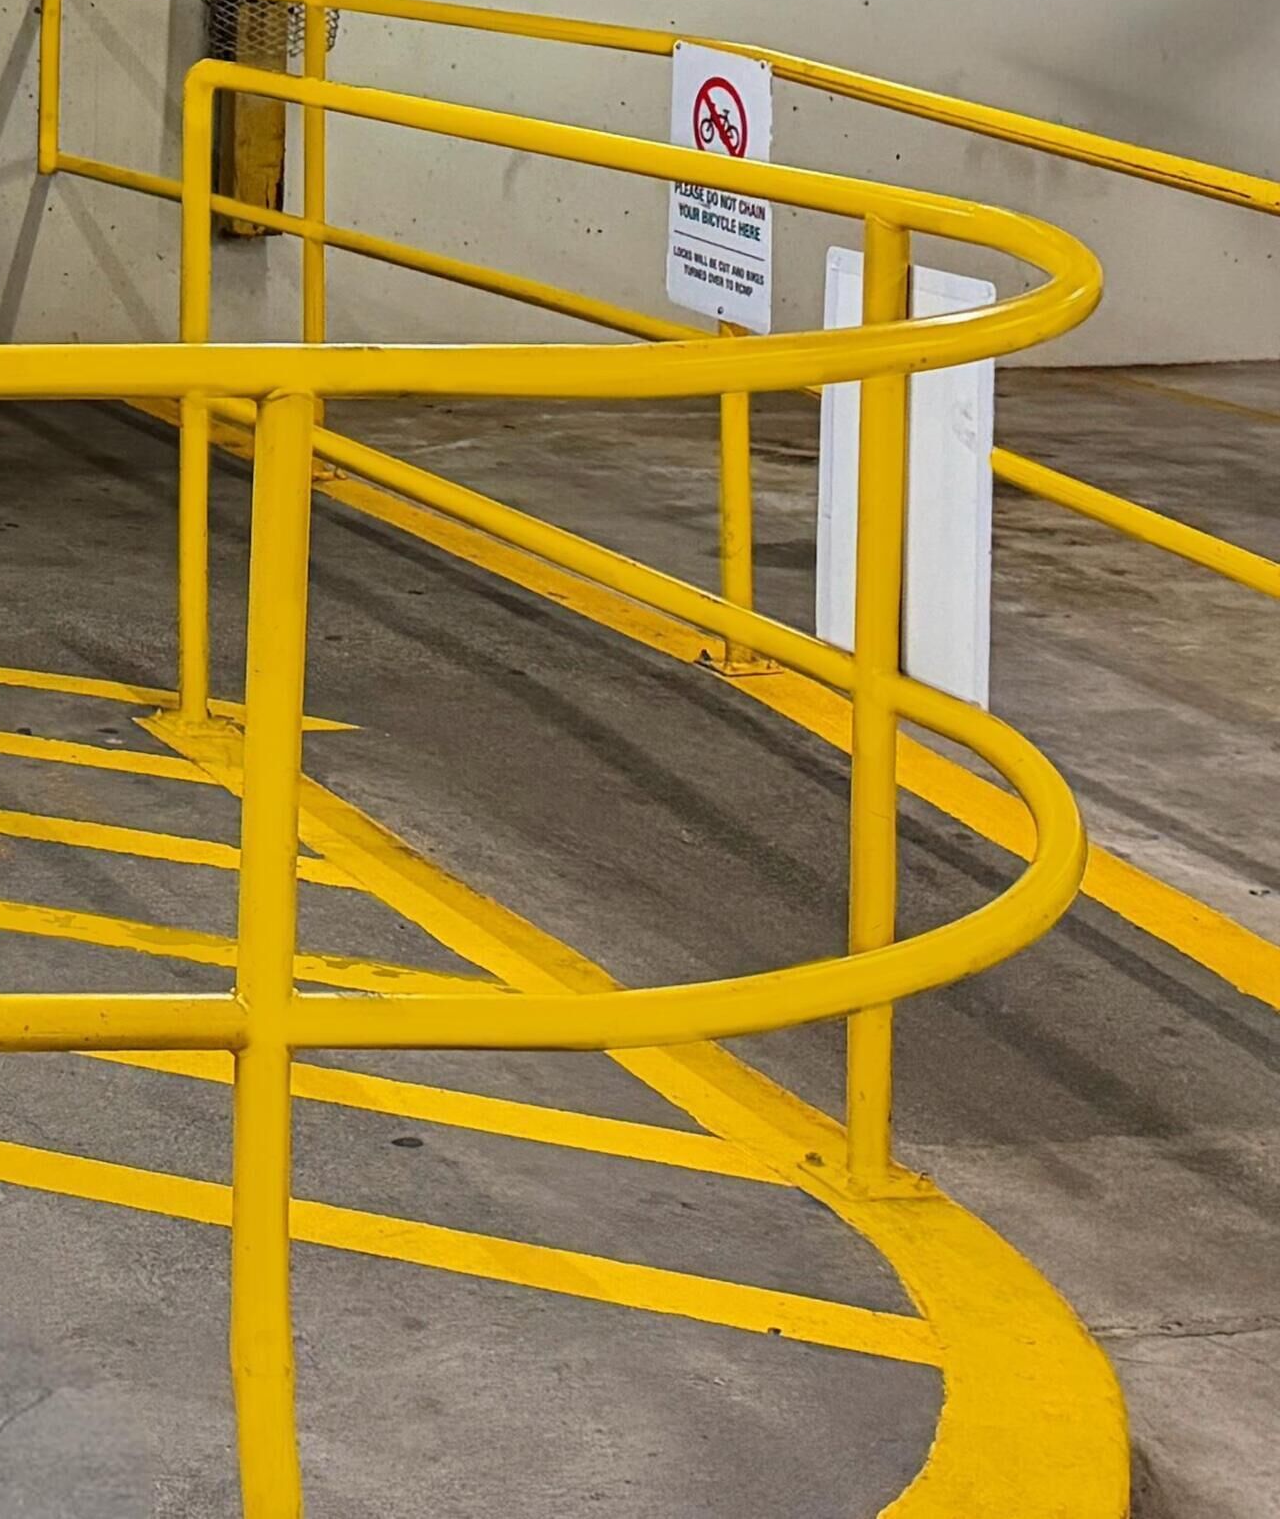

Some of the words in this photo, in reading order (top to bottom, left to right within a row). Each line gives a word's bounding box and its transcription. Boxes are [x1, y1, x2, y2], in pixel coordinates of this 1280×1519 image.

[679, 203, 699, 221] YOUR
[702, 211, 736, 233] BICYCLE
[738, 221, 760, 241] HERE
[707, 190, 718, 205] DO
[720, 194, 736, 212] NOT
[739, 200, 765, 220] CHAIN
